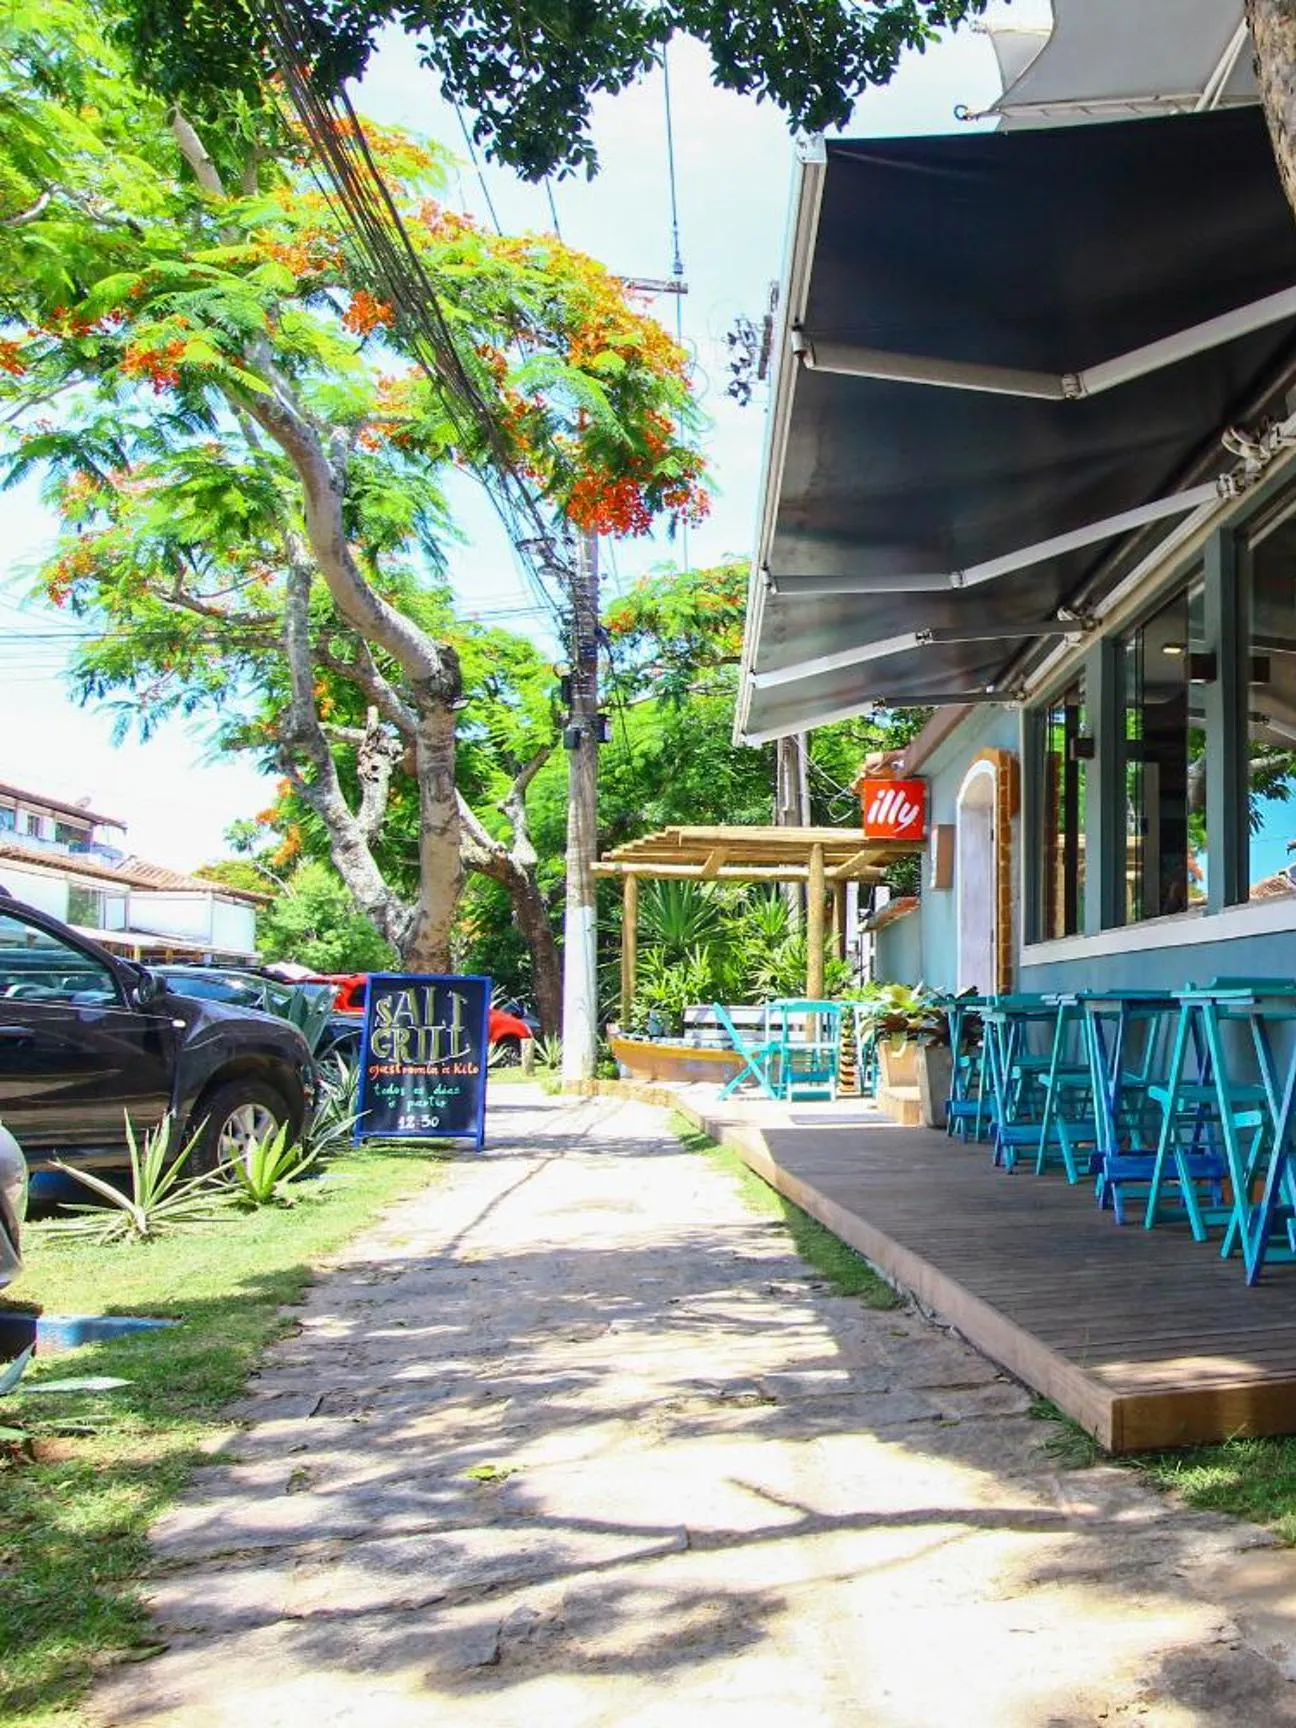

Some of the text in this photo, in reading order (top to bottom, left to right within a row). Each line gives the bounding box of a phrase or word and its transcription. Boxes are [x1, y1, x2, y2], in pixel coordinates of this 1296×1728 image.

[867, 788, 920, 834] illy
[374, 986, 468, 1028] SALT
[371, 1027, 471, 1065] GRILL
